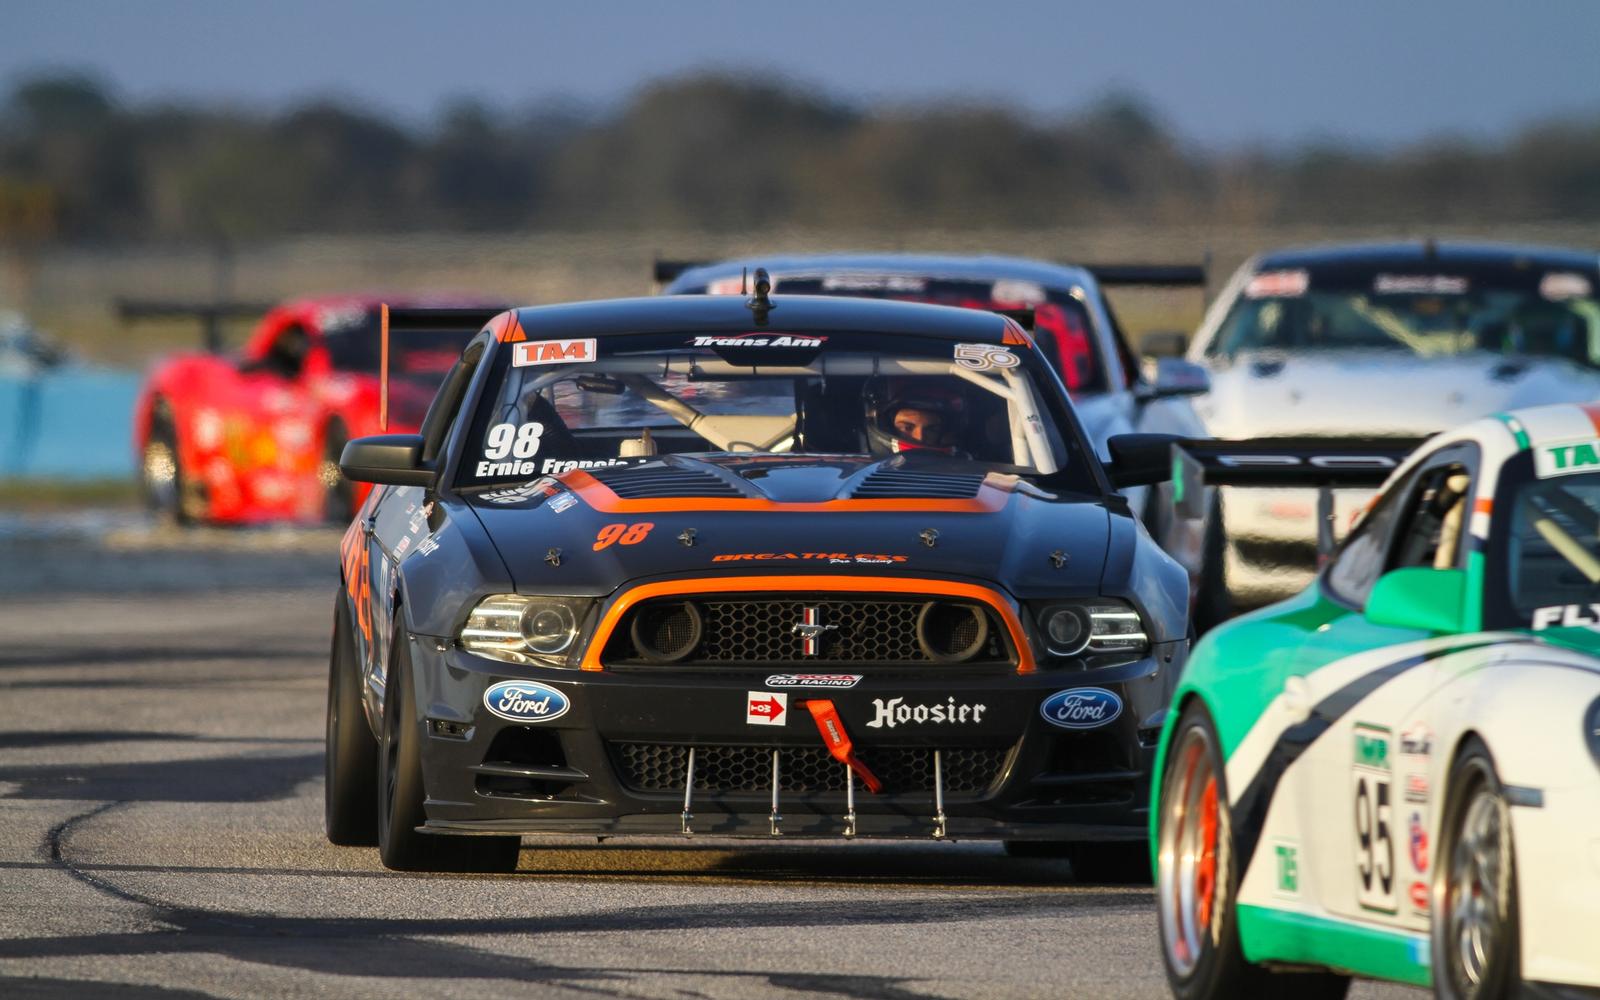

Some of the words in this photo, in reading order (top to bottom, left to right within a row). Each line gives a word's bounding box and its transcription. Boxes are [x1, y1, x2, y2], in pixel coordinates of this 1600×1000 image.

[521, 341, 588, 361] TA4
[693, 336, 769, 346] Trans
[769, 336, 822, 347] Am
[954, 348, 1020, 371] 50
[485, 422, 544, 460] 98
[475, 460, 535, 477] Ernie
[592, 523, 654, 551] 98
[711, 552, 909, 562] BREATHLESS
[800, 679, 853, 687] RACING
[499, 687, 550, 714] Ford
[865, 696, 987, 728] Hoosier
[1057, 695, 1107, 719] Ford
[1355, 778, 1394, 896] 95
